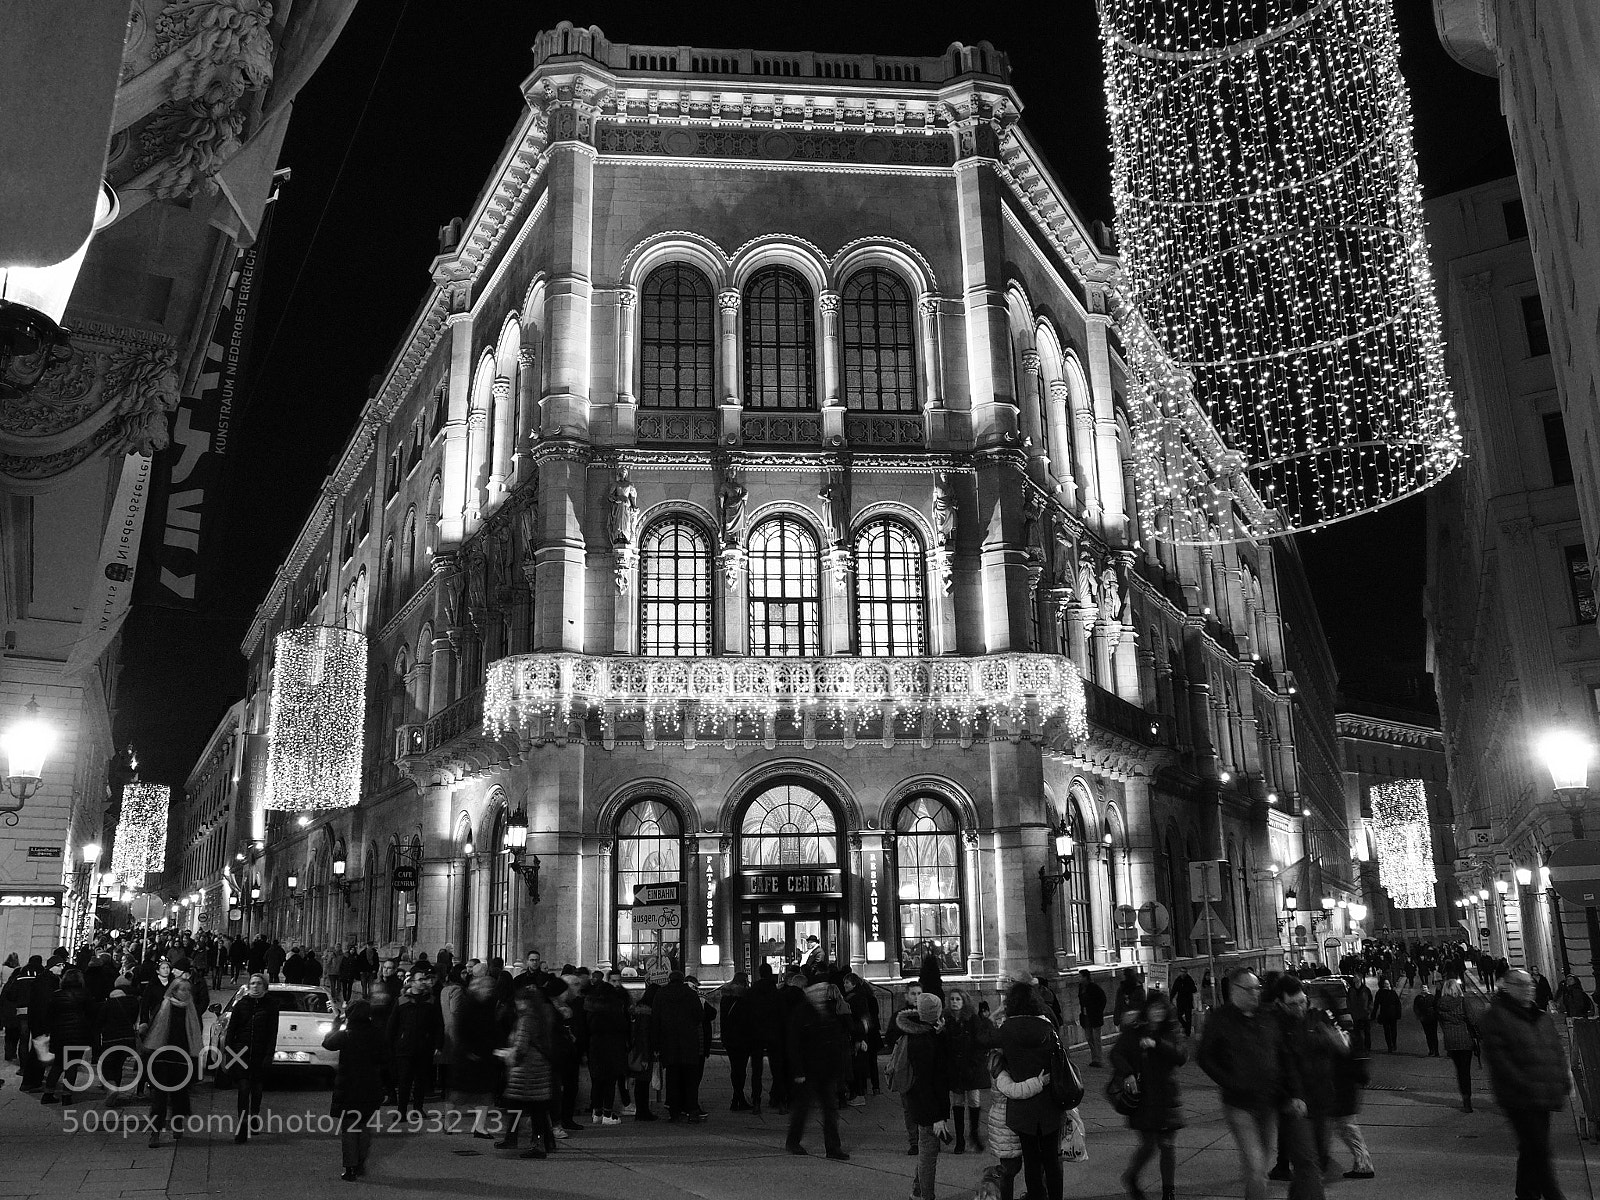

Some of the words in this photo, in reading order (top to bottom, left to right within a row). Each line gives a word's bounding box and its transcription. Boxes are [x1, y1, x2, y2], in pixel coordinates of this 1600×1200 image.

[214, 378, 235, 455] KUNSTRAUM
[226, 249, 257, 376] NIEDEROESTERREICH
[647, 887, 675, 900] EINBAHN
[706, 855, 714, 945] PATISSERIE
[750, 876, 779, 893] CAFE
[787, 875, 836, 892] CENTRAL
[869, 853, 879, 942] RESTAURANT
[633, 914, 658, 924] ausgen.
